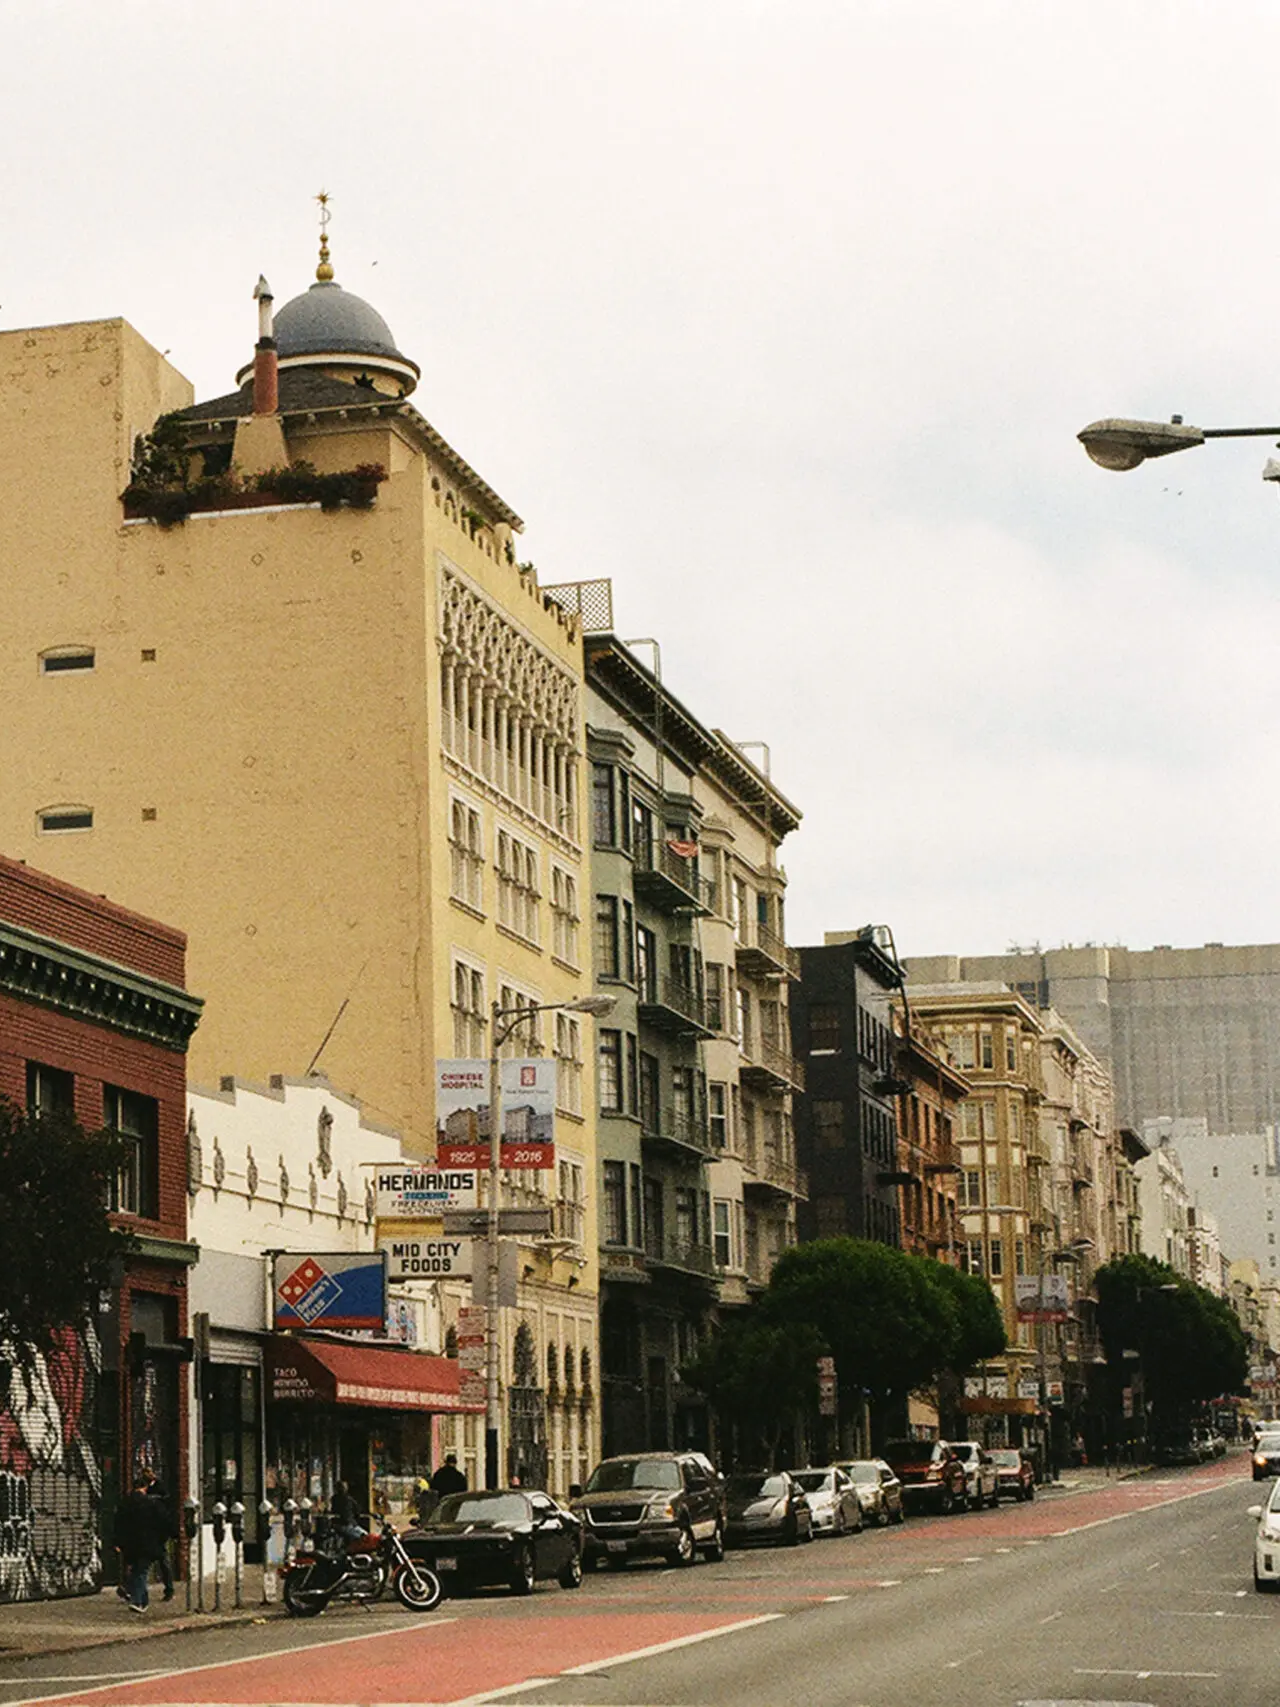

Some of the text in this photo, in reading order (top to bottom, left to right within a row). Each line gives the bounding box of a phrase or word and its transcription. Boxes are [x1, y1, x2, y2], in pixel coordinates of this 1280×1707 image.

[441, 1073, 484, 1081] CHINESE
[441, 1081, 485, 1089] HOSPITAL
[449, 1151, 477, 1163] 1925
[514, 1150, 543, 1163] 2016
[379, 1173, 474, 1191] HERMANOS
[392, 1242, 461, 1257] MID CITY
[401, 1258, 452, 1273] FOODS
[274, 1367, 297, 1377] TACO
